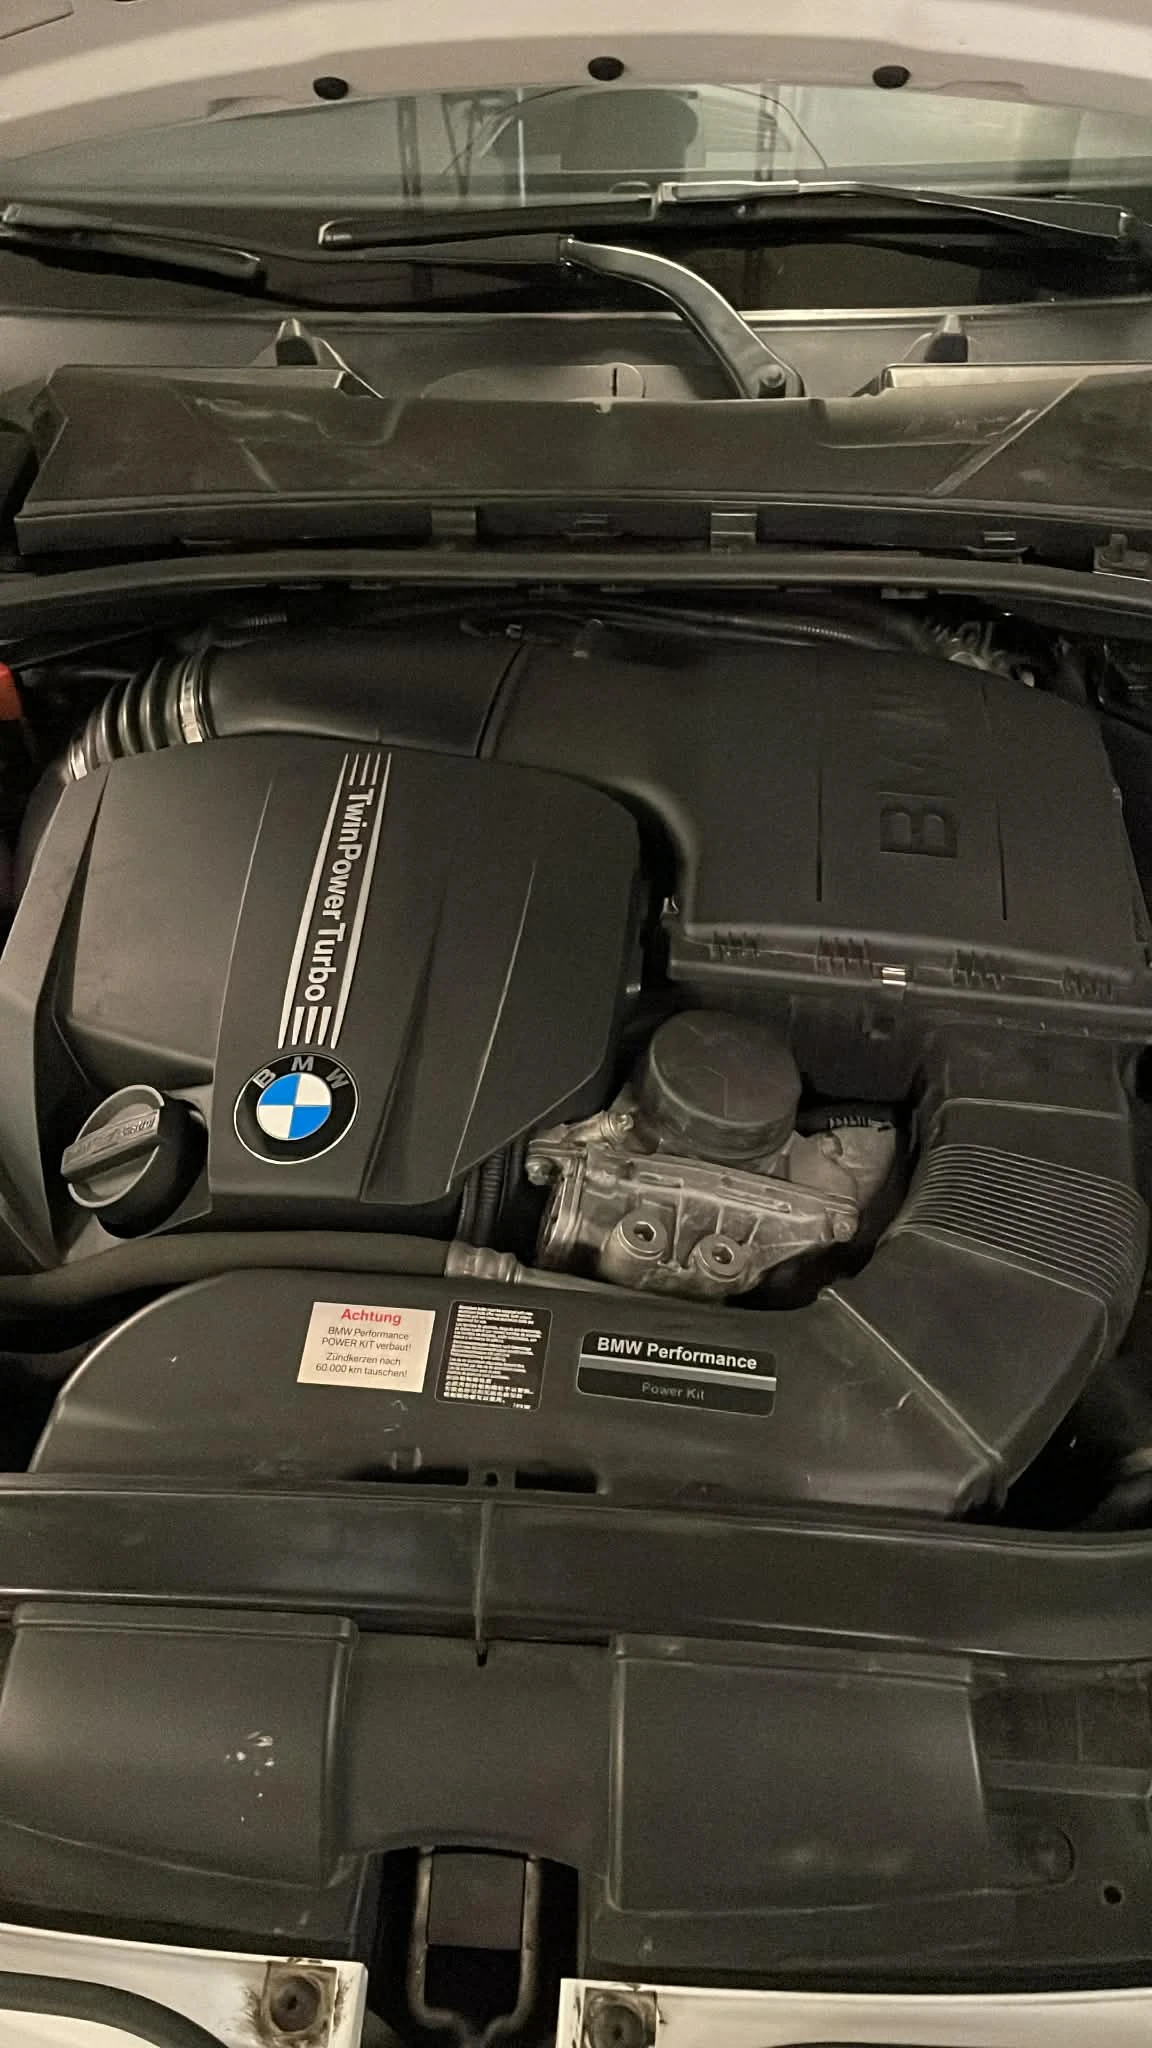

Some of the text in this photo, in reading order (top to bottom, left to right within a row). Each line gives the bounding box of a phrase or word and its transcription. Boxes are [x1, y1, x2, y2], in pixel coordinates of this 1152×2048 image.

[304, 787, 374, 1002] TwinPower Turbo
[252, 1055, 350, 1090] BMW
[341, 1308, 402, 1326] Achtung
[328, 1326, 409, 1340] BMW Performance
[321, 1337, 412, 1352] POWER KIT verbaut!
[597, 1336, 758, 1370] BMW Performance
[326, 1352, 401, 1366] Zündkerzen nach
[315, 1363, 408, 1378] 60.000 km tauschen!
[641, 1382, 705, 1401] Power Kit
